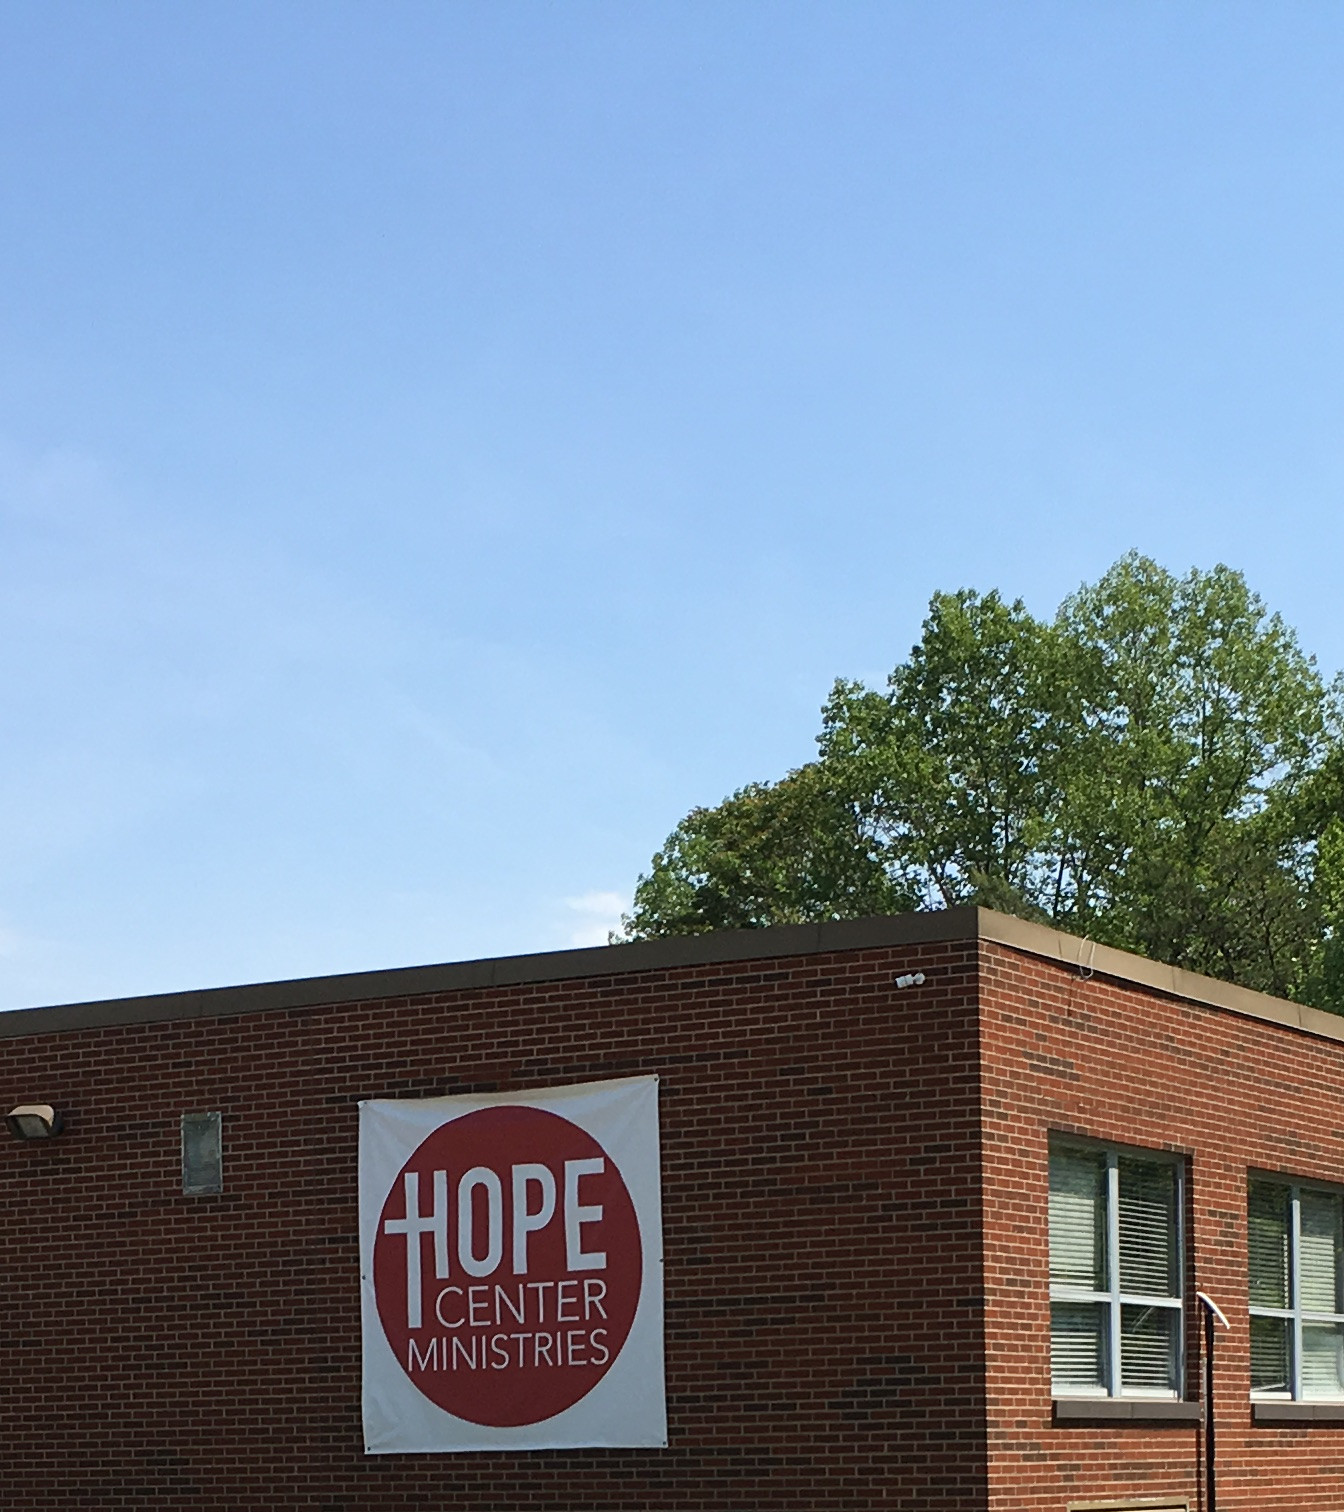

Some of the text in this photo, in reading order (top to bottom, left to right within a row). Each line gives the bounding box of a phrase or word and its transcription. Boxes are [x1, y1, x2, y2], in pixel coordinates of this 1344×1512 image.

[384, 1157, 607, 1328] HOPE
[436, 1279, 608, 1328] CENTER
[408, 1328, 609, 1372] MINISTRIES
